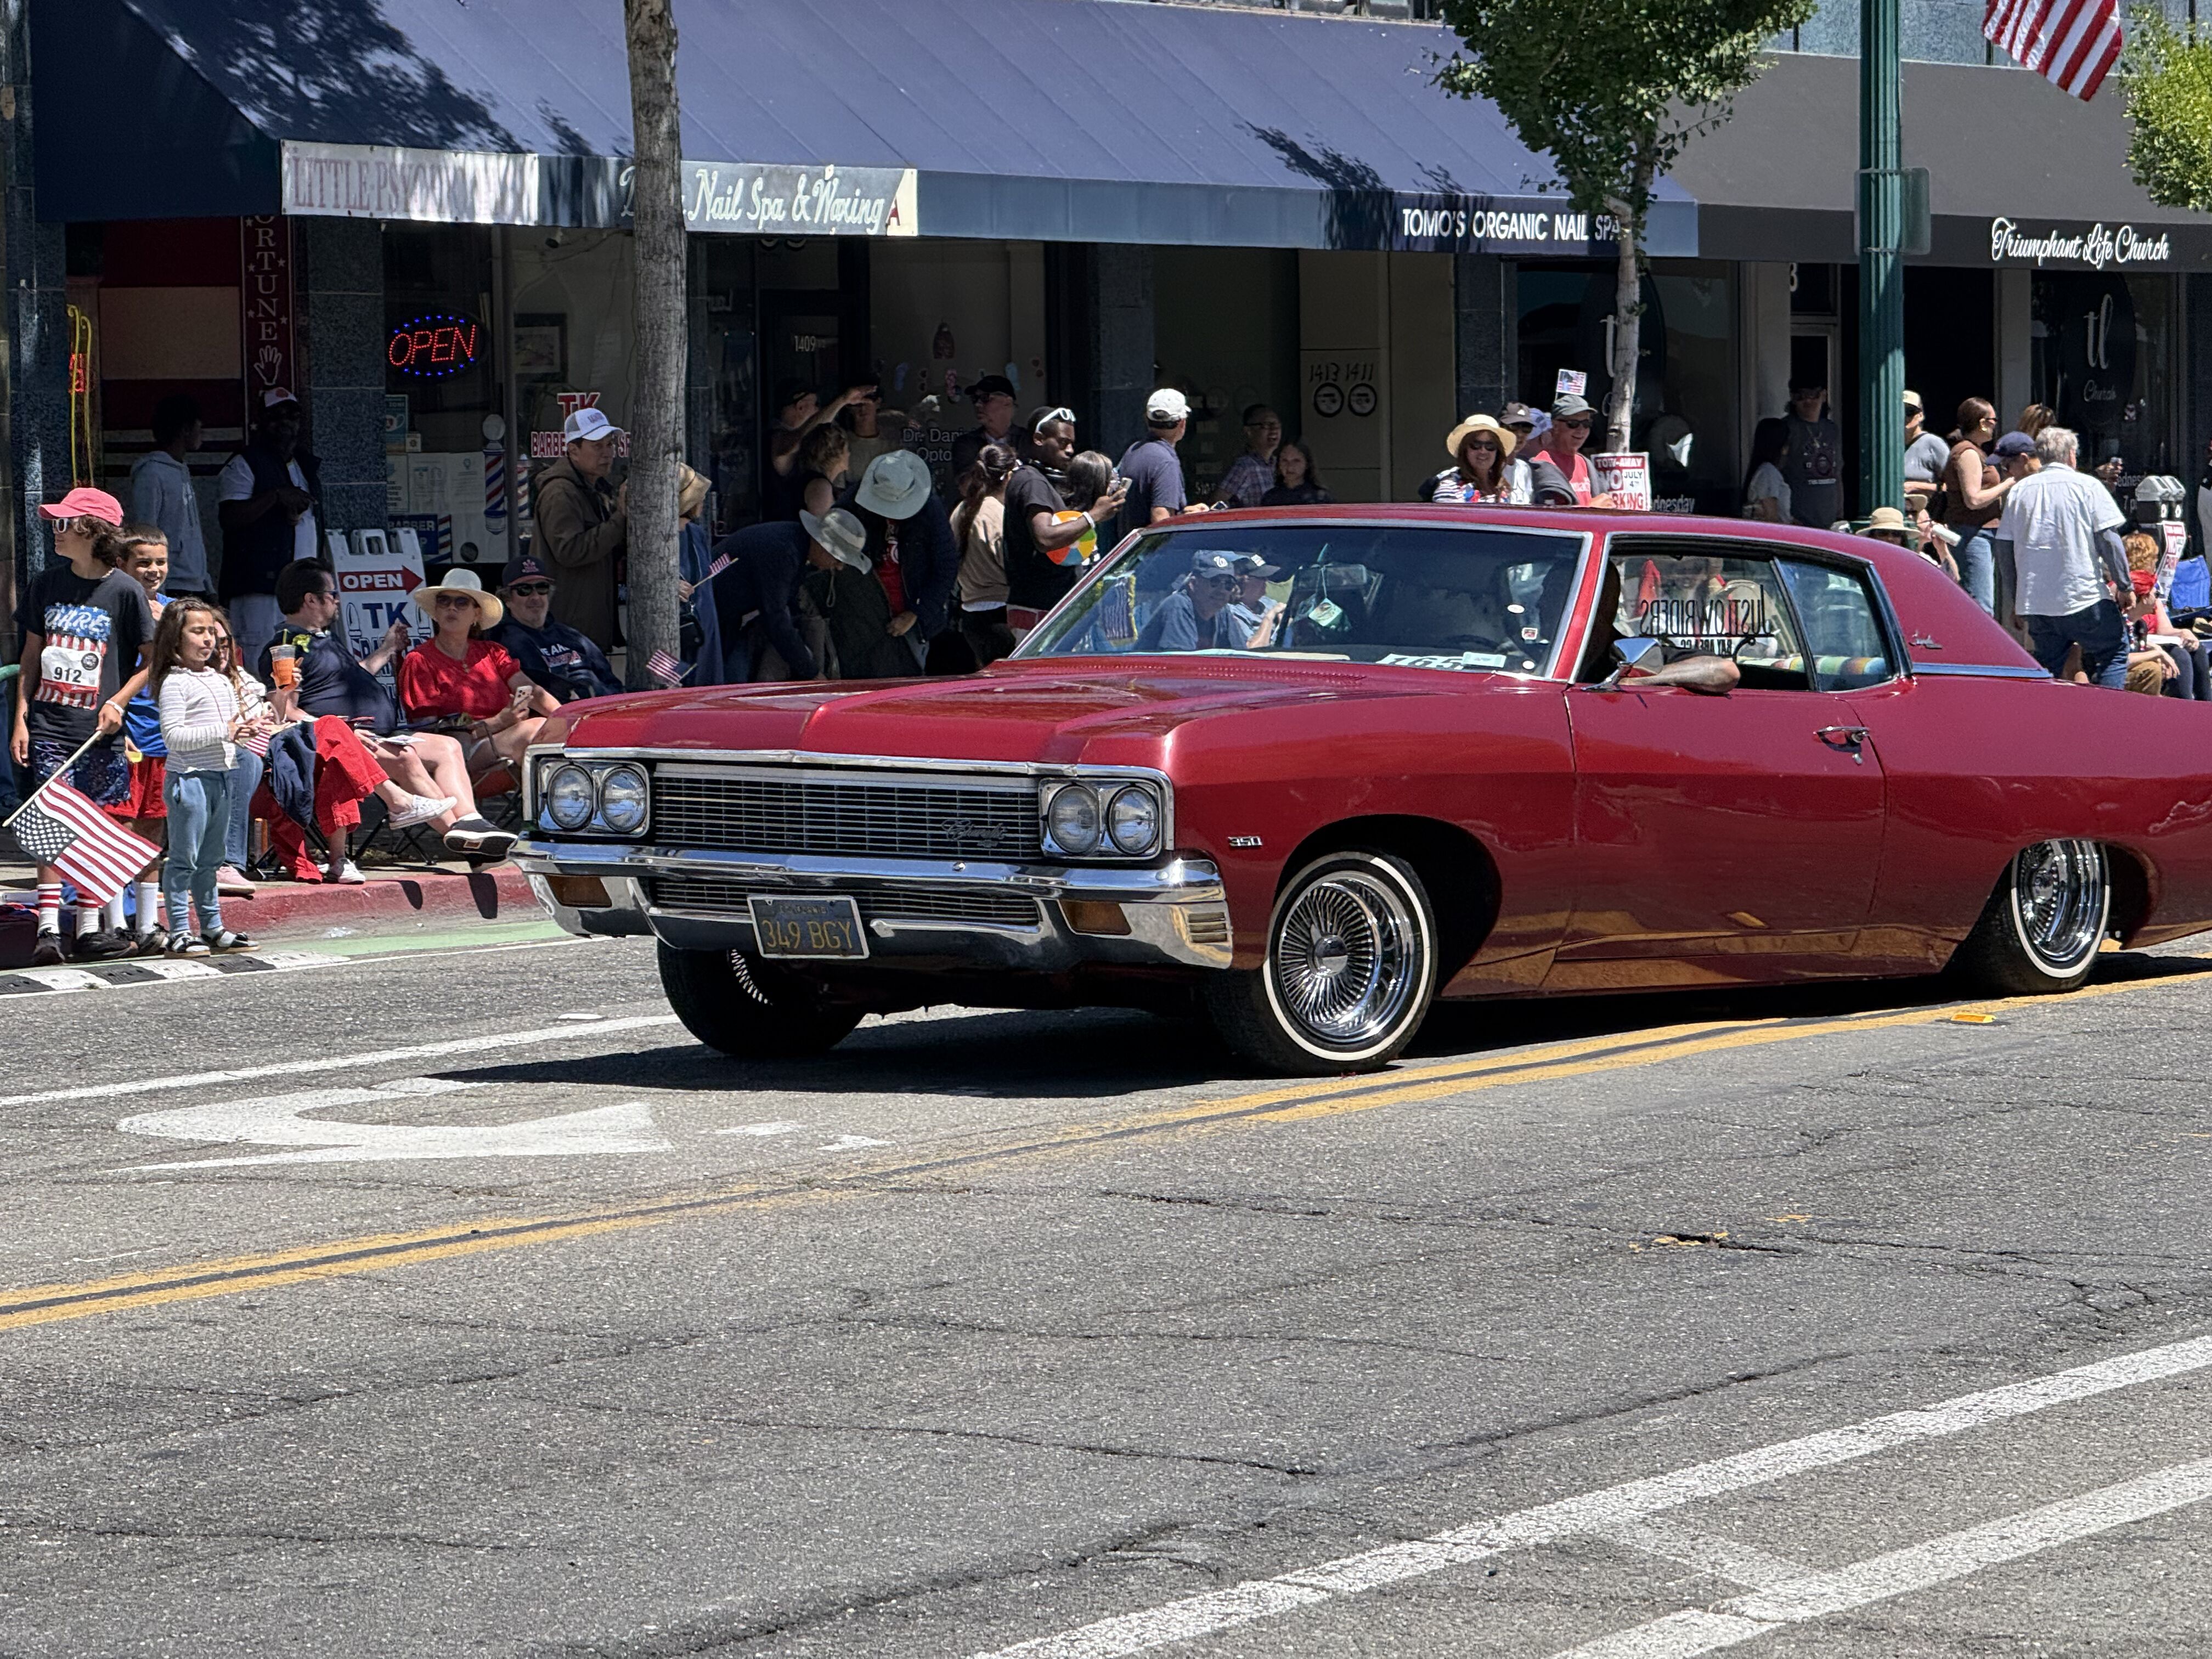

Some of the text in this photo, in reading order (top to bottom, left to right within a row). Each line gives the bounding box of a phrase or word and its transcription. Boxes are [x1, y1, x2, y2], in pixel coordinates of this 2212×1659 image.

[292, 157, 370, 211] LITTLE
[689, 168, 743, 222] Nail
[746, 177, 786, 230] Spa
[791, 173, 811, 222] &
[812, 177, 885, 235] Waxing
[1403, 208, 1466, 237] TOMO'S
[1472, 211, 1548, 240] ORGANIC
[1554, 214, 1589, 241] NAIL
[1991, 217, 2169, 270] Triumphant Life Church
[388, 324, 476, 366] OPEN
[794, 335, 816, 352] 1409
[531, 431, 567, 458] BARBE
[903, 428, 923, 442] Dr.
[1596, 458, 1643, 467] TOW-AWAY
[1611, 493, 1644, 510] RKING
[1653, 495, 1695, 513] dnesday
[342, 573, 403, 589] OPEN
[362, 602, 412, 629] TK
[53, 667, 82, 683] 912
[1228, 836, 1263, 847] 350
[761, 919, 853, 949] 349 BGY
